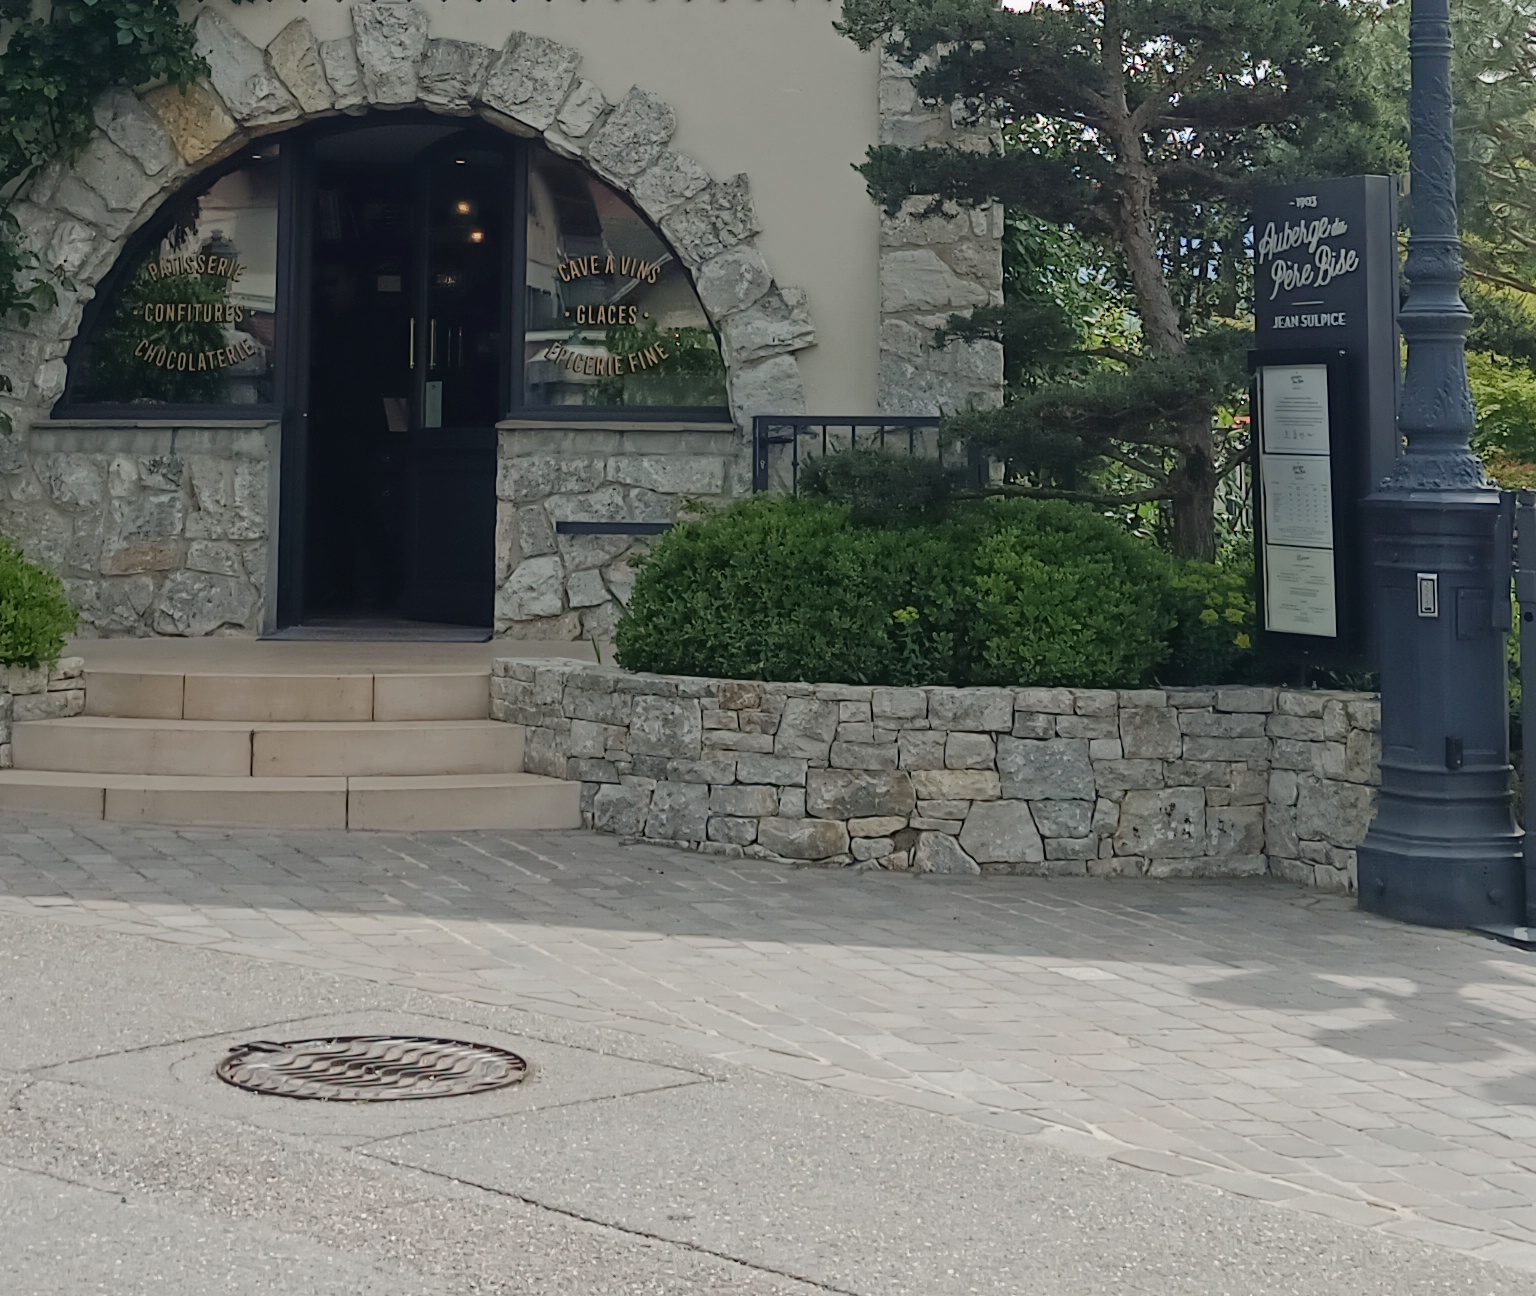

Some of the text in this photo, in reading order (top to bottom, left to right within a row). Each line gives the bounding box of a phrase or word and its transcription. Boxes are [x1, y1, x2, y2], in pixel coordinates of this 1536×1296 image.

[1258, 216, 1332, 265] Auberge
[558, 255, 601, 283] CAVE
[620, 255, 661, 284] VINS
[1269, 244, 1360, 301] Père Bise
[144, 303, 245, 322] CONFITURES
[576, 304, 639, 324] GLACES
[1272, 312, 1347, 329] JEAN SULPICE
[134, 338, 257, 372] CHOCOLATERIE
[627, 341, 670, 373] FINE
